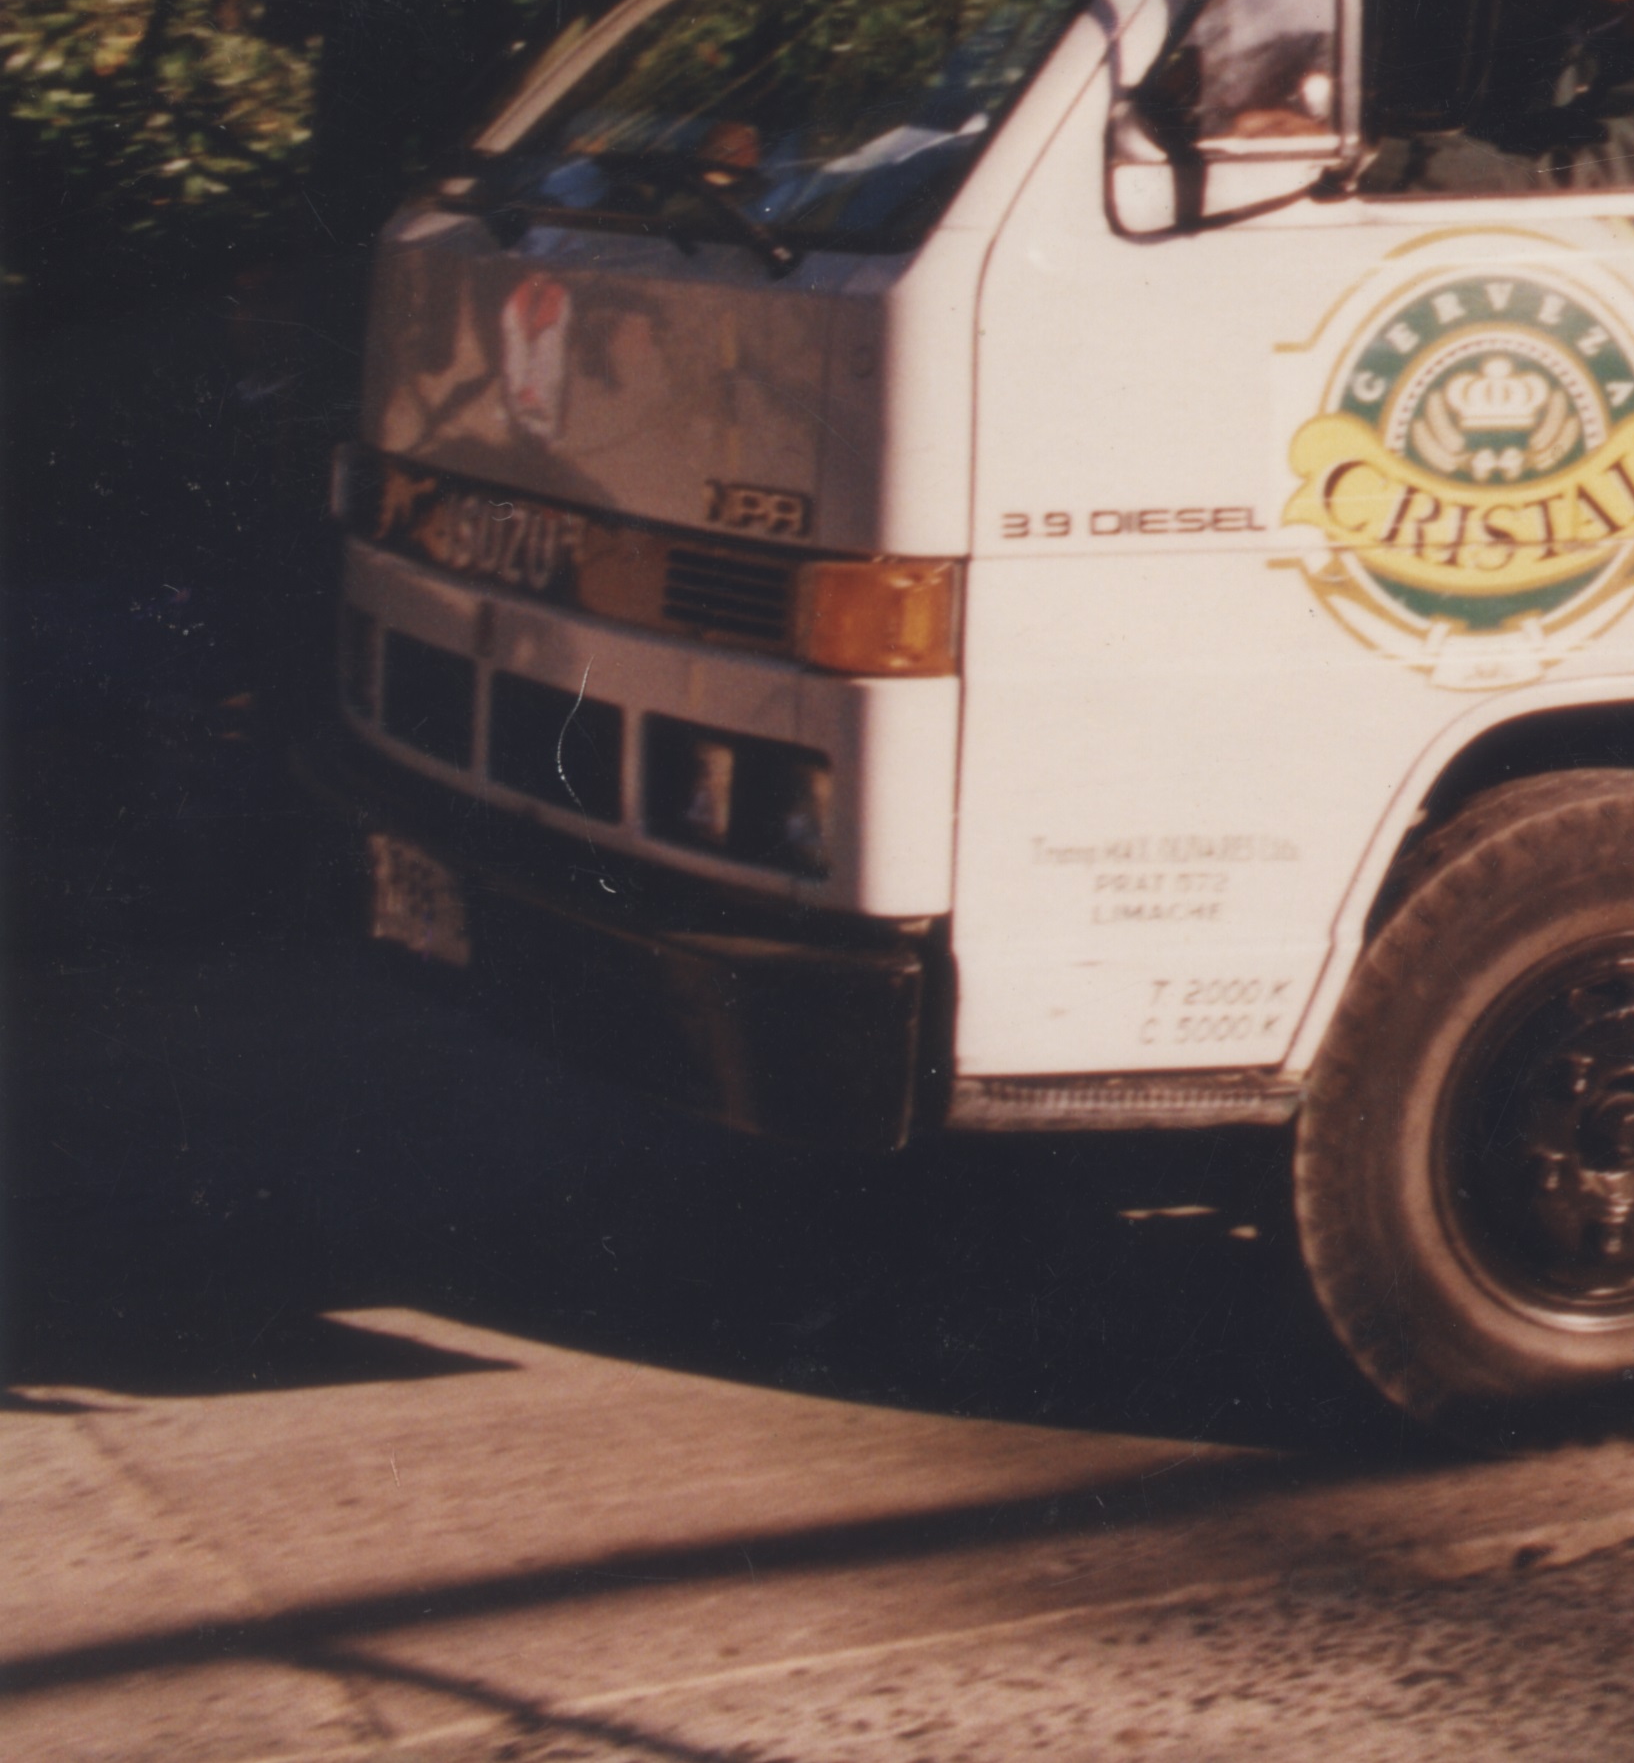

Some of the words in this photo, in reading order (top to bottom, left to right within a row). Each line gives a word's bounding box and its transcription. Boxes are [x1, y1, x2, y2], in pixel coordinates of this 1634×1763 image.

[1089, 507, 1267, 537] DIESEL
[1093, 872, 1166, 895] PRAT
[1091, 901, 1225, 926] LIMACHE
[1150, 978, 1172, 1007] T
[1182, 977, 1261, 1006] 2000
[1138, 1016, 1161, 1046] C
[1175, 1014, 1253, 1045] 5000
